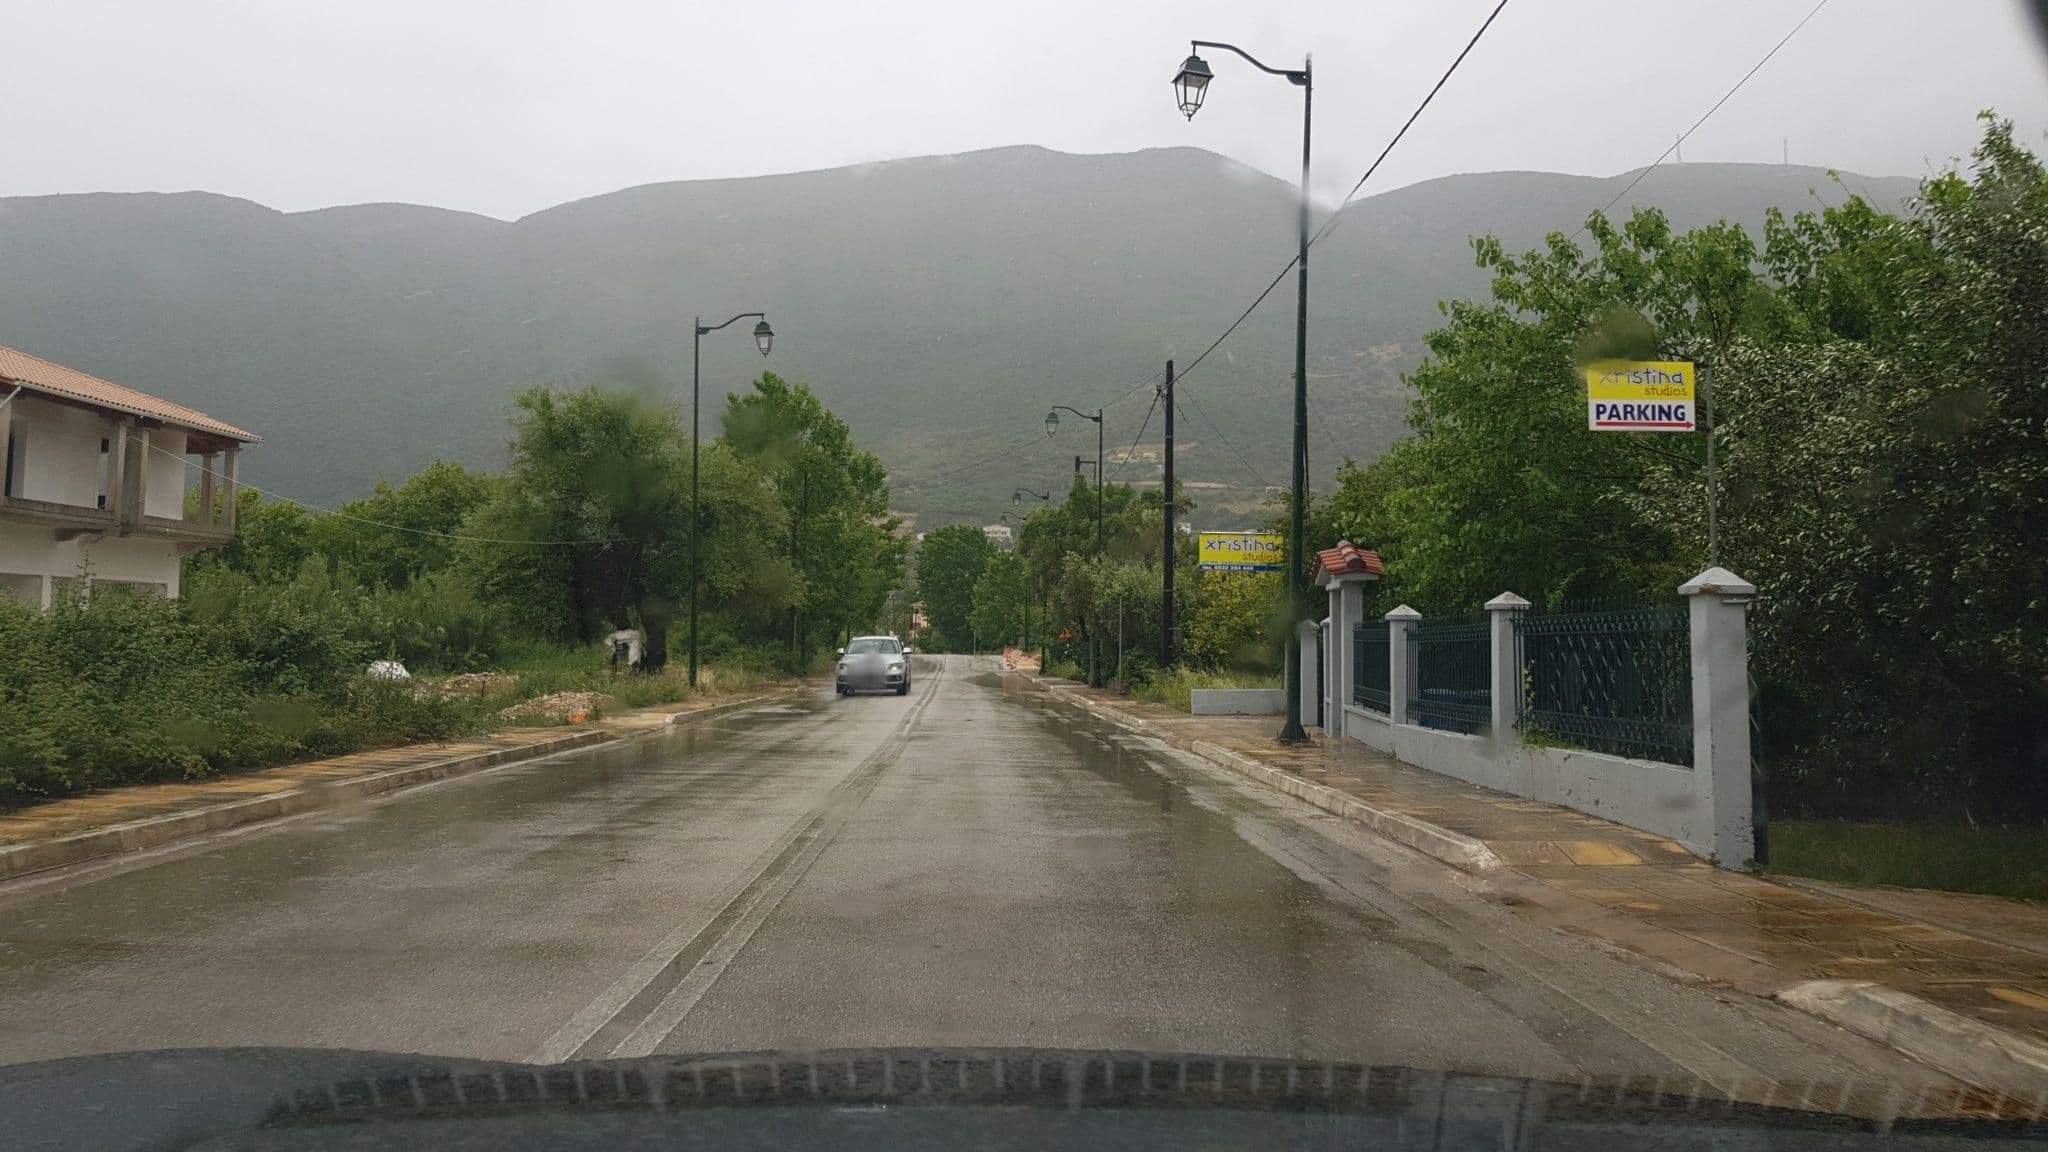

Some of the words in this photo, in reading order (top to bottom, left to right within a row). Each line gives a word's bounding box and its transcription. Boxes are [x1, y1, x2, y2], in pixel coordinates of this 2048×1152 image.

[1599, 368, 1684, 386] xristina
[1644, 385, 1688, 397] studios
[1595, 404, 1686, 421] PARKING
[1205, 537, 1277, 551] xristina
[1242, 552, 1279, 561] studios
